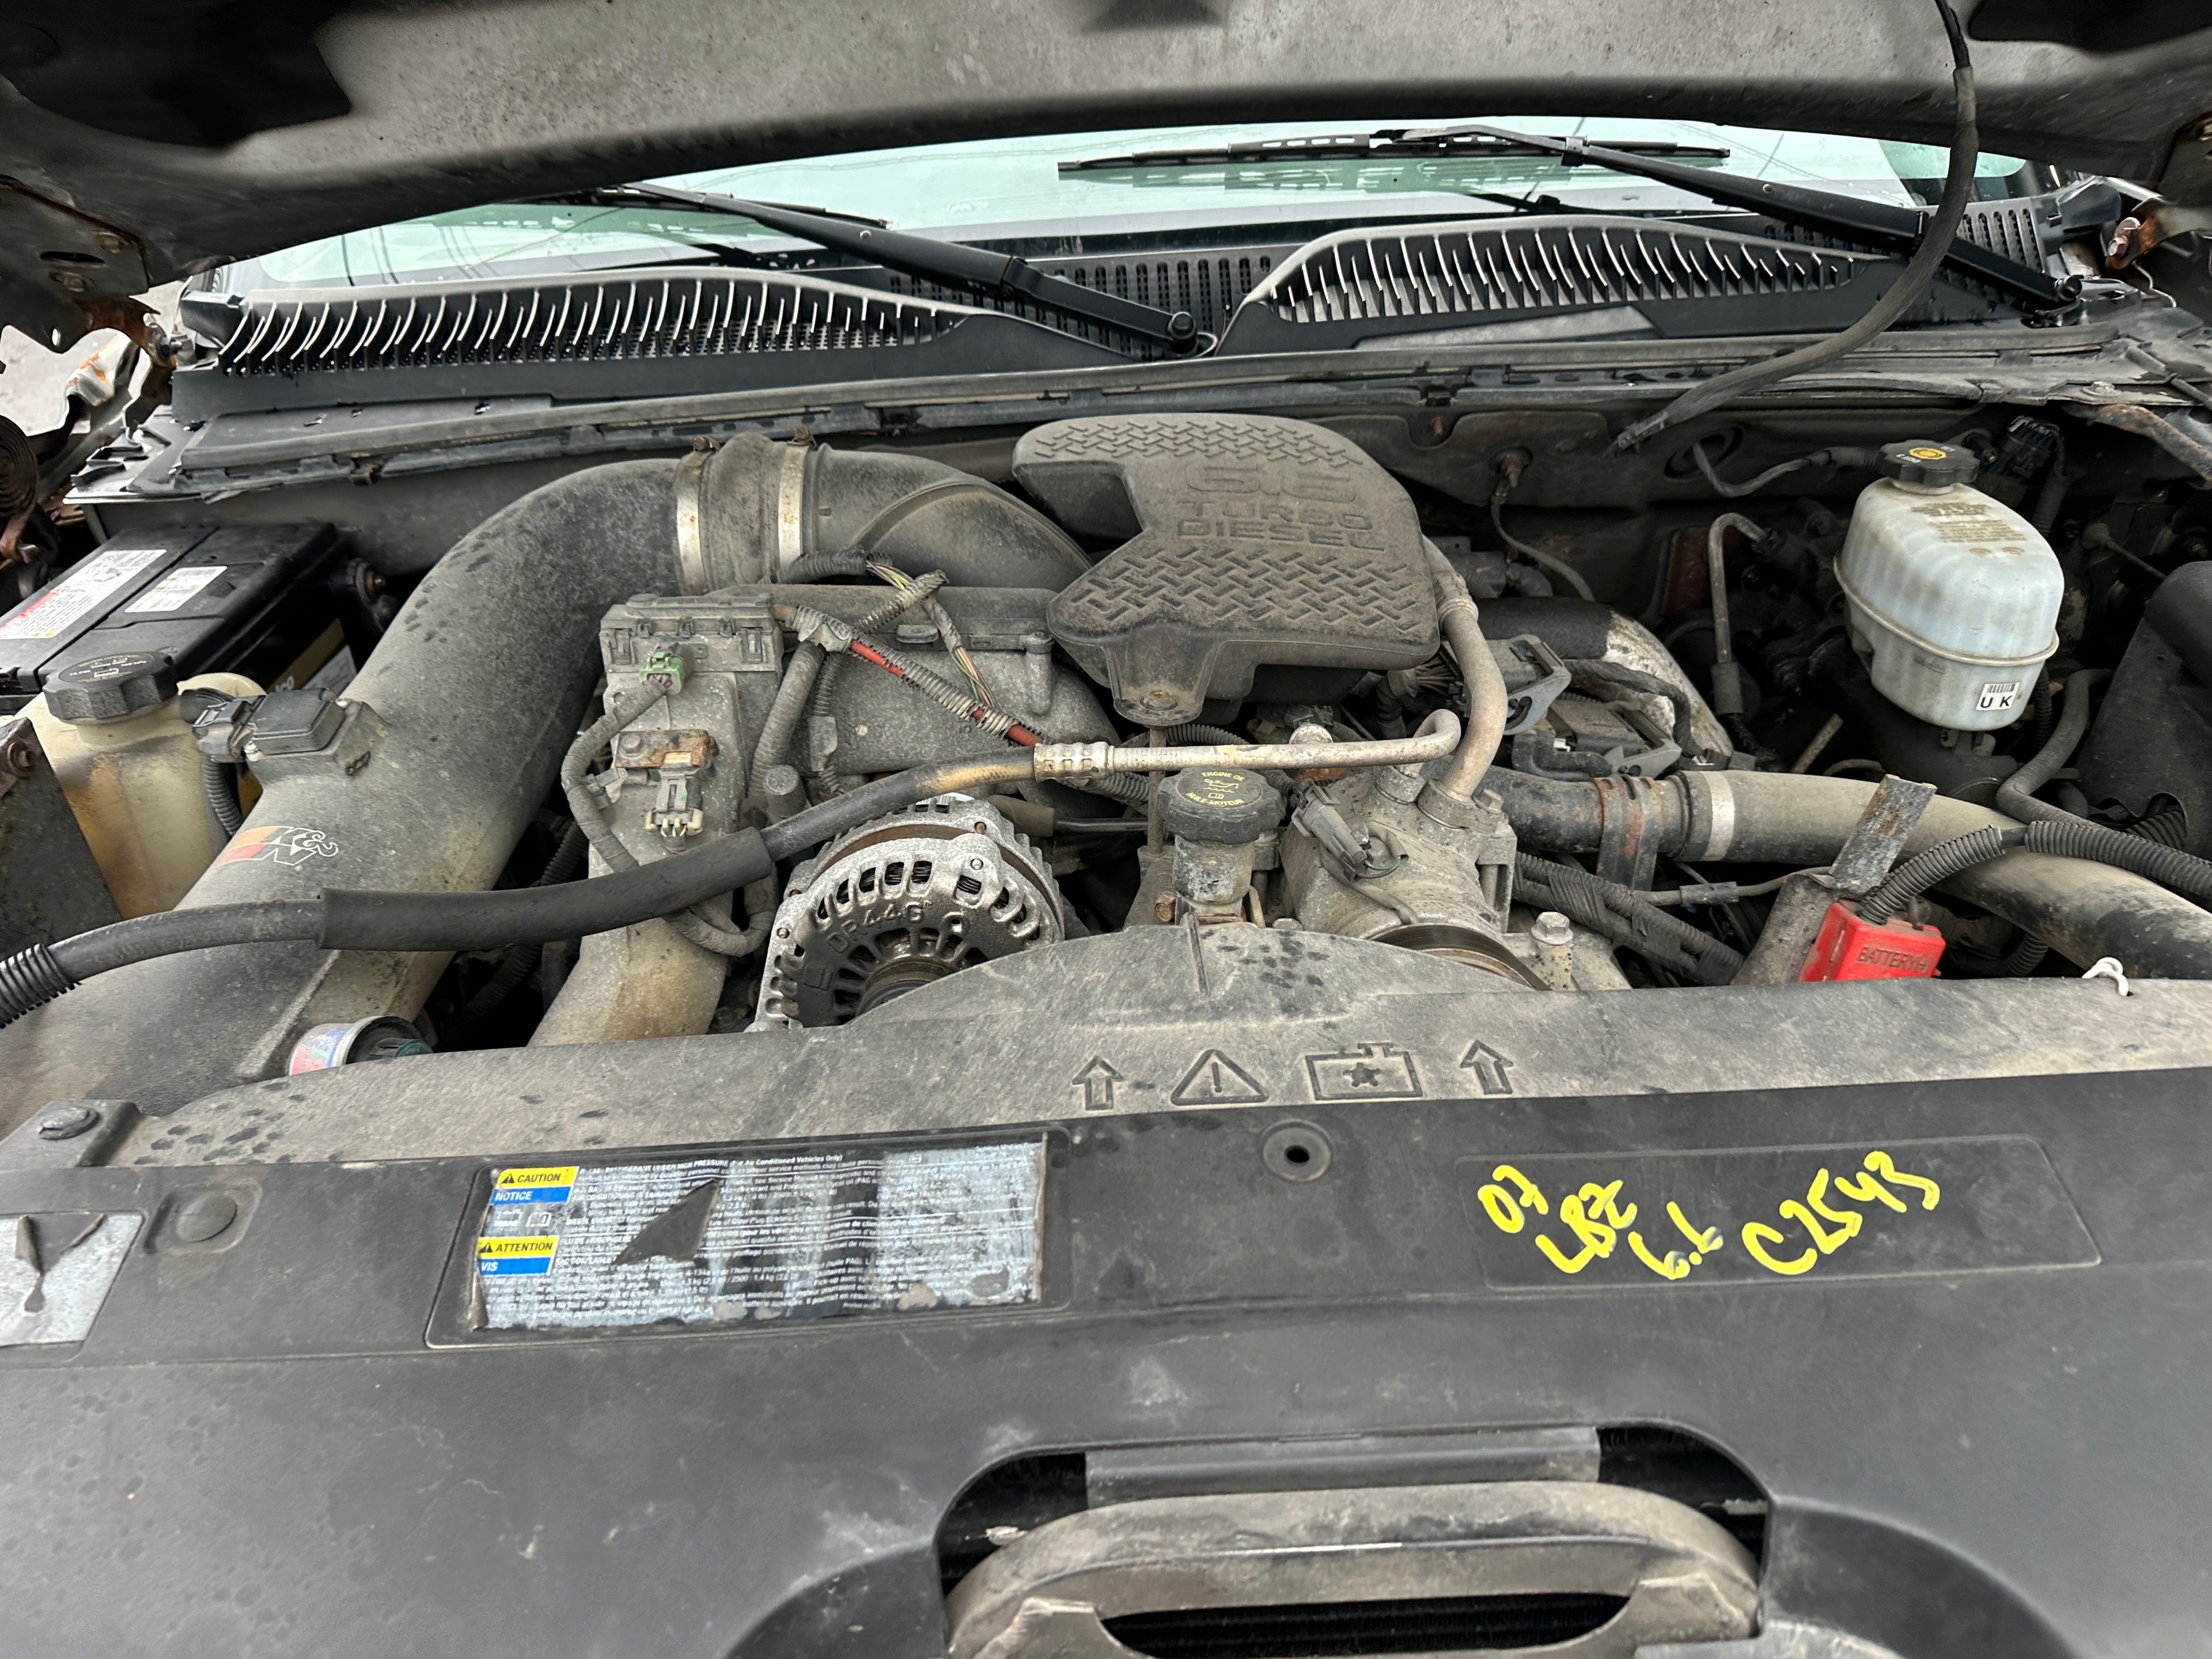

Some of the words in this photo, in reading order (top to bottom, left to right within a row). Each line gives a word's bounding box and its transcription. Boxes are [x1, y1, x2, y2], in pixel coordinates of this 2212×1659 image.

[1180, 500, 1373, 530] TURBO
[1177, 518, 1384, 551] DIESEL
[1186, 793, 1245, 806] HUILE-MOTEUR
[694, 1159, 729, 1167] PRESSURE
[756, 1157, 795, 1166] Conditioned
[797, 1155, 825, 1164] Vehicles
[825, 1154, 843, 1162] Only)
[688, 1167, 719, 1176] personnel
[793, 1163, 821, 1171] methods
[822, 1162, 835, 1171] may
[517, 1173, 560, 1183] CAUTION
[494, 1191, 533, 1201] NOTICE
[1477, 1165, 1549, 1234] 07
[1535, 1180, 1638, 1274] LBZ
[1627, 1201, 1724, 1281] 6.6
[1741, 1151, 1940, 1275] C2543
[495, 1242, 553, 1252] ATTENTION
[480, 1261, 499, 1271] VIS
[820, 1284, 856, 1294] pourraient
